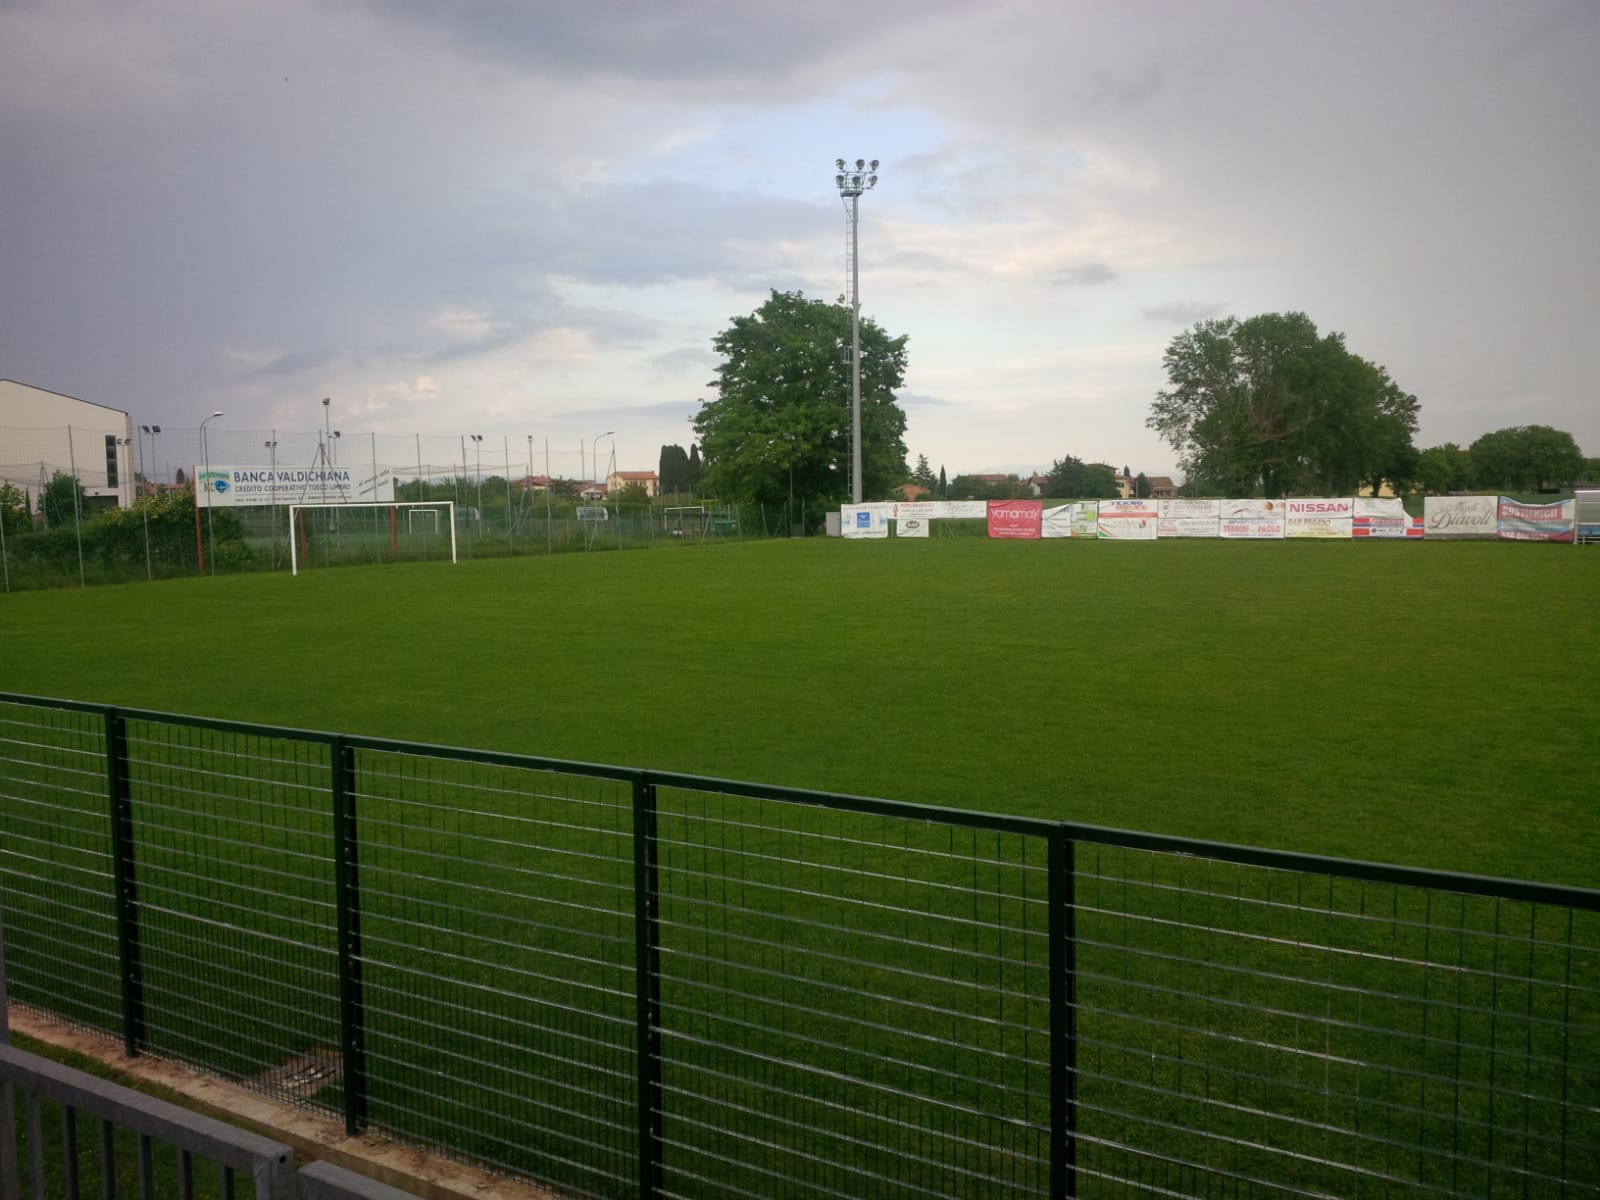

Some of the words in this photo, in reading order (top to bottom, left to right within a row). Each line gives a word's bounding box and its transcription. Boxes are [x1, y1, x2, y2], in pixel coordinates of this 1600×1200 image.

[234, 472, 274, 482] BANCA
[277, 471, 350, 482] VALDICHIANA
[235, 485, 262, 493] CREDITO
[1289, 503, 1348, 513] NISSAN
[991, 508, 1040, 520] yamamay
[1428, 510, 1490, 529] Diavoli
